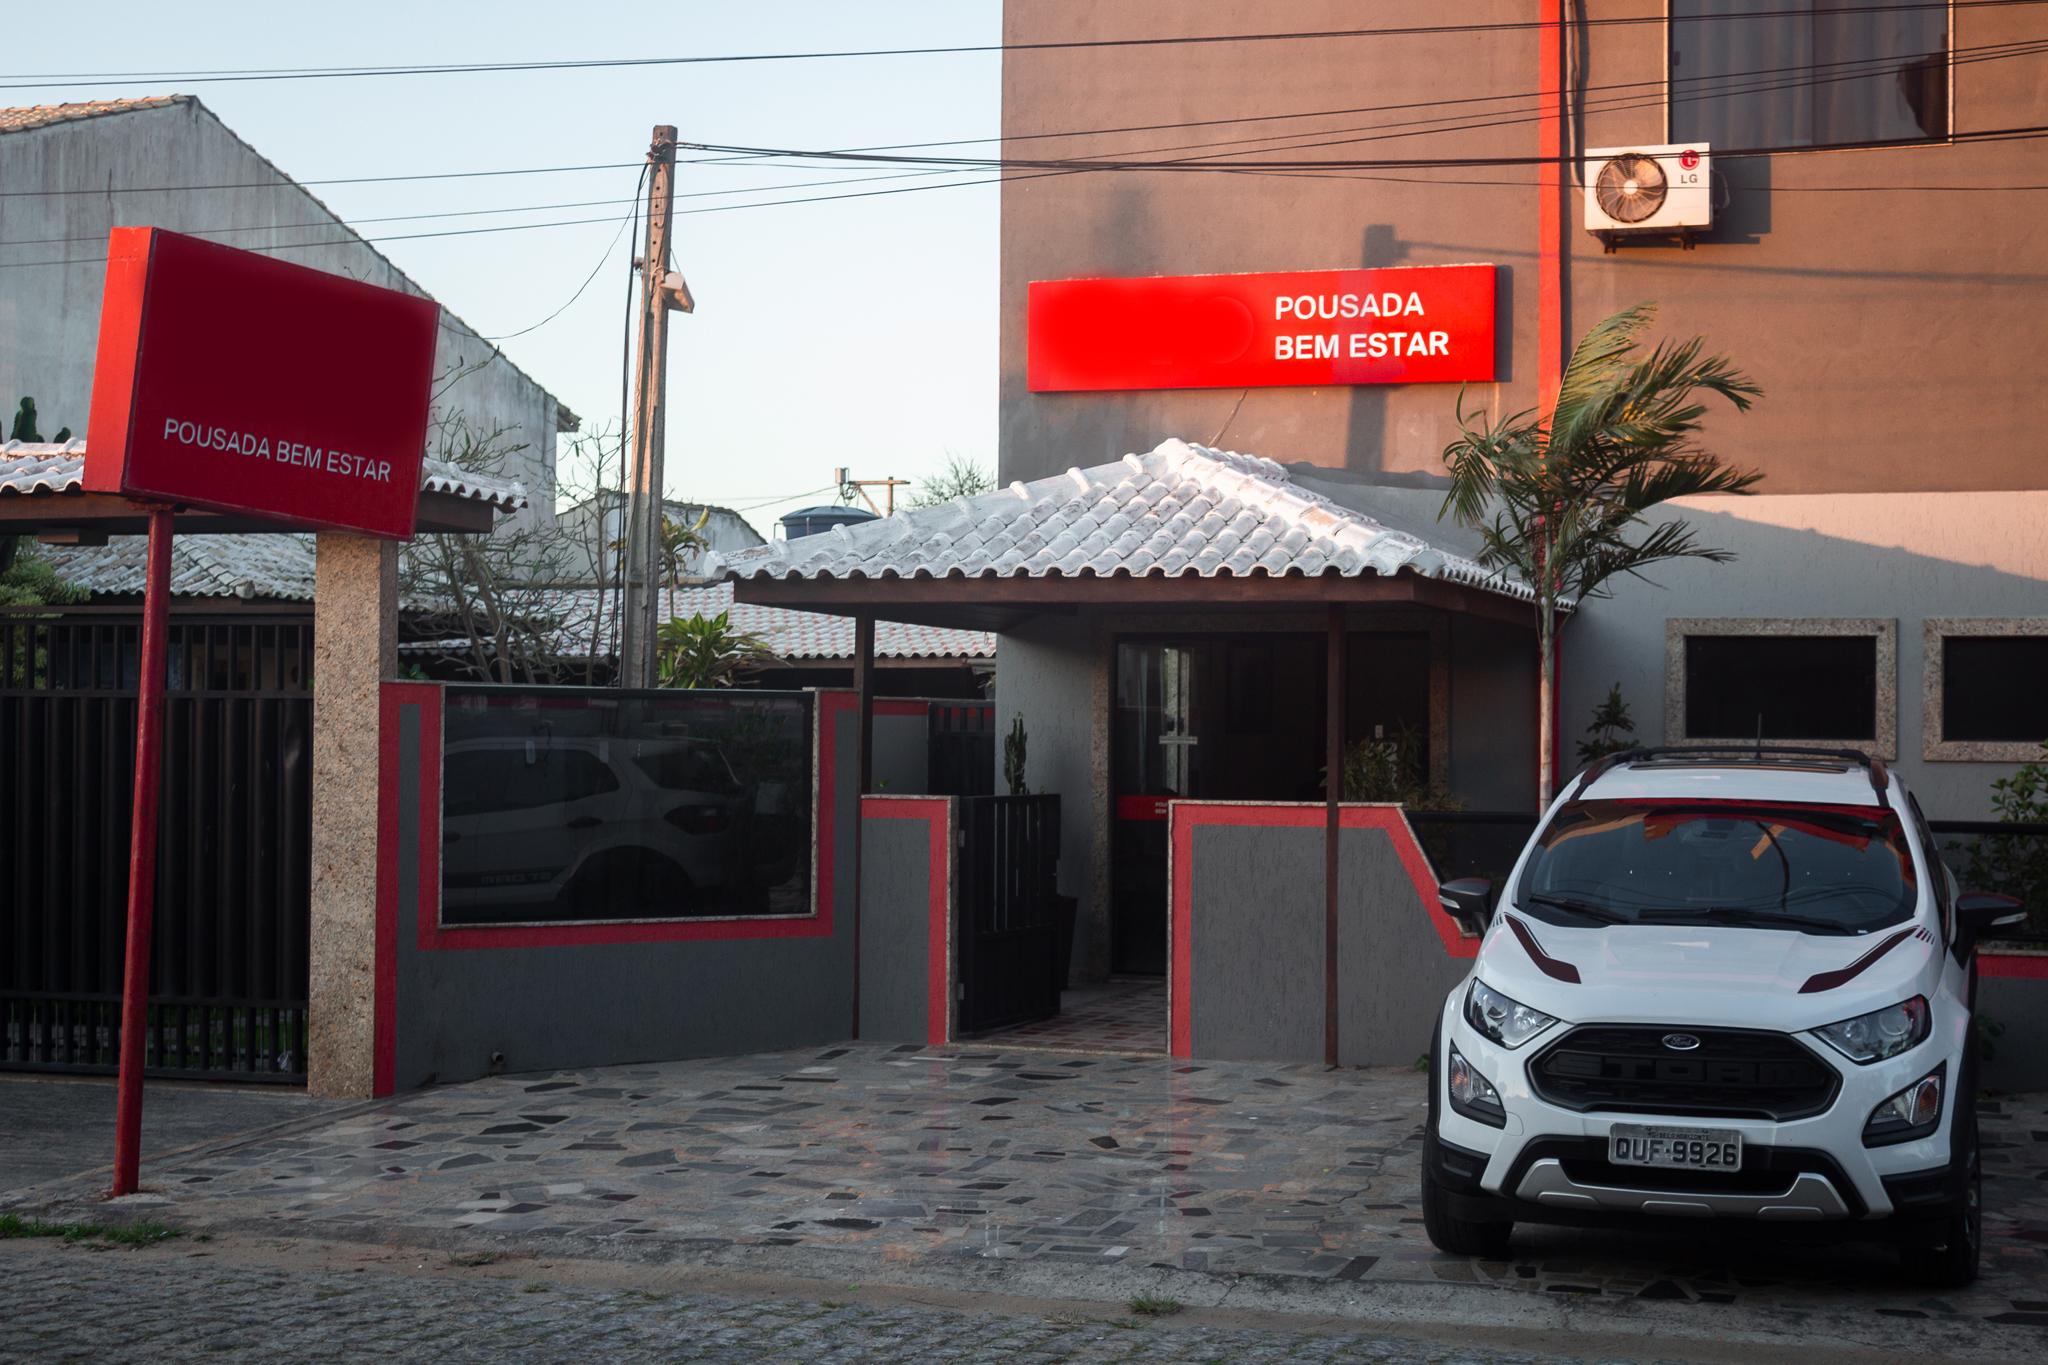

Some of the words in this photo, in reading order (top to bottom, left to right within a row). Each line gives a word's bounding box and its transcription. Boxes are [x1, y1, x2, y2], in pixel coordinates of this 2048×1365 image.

[1681, 174, 1698, 184] LG
[1275, 292, 1425, 320] POUSADA
[1275, 334, 1340, 360] BEM
[1350, 331, 1449, 358] ESTAR
[164, 418, 271, 460] POUSADA
[276, 440, 322, 469] BEM
[326, 451, 392, 482] ESTAR
